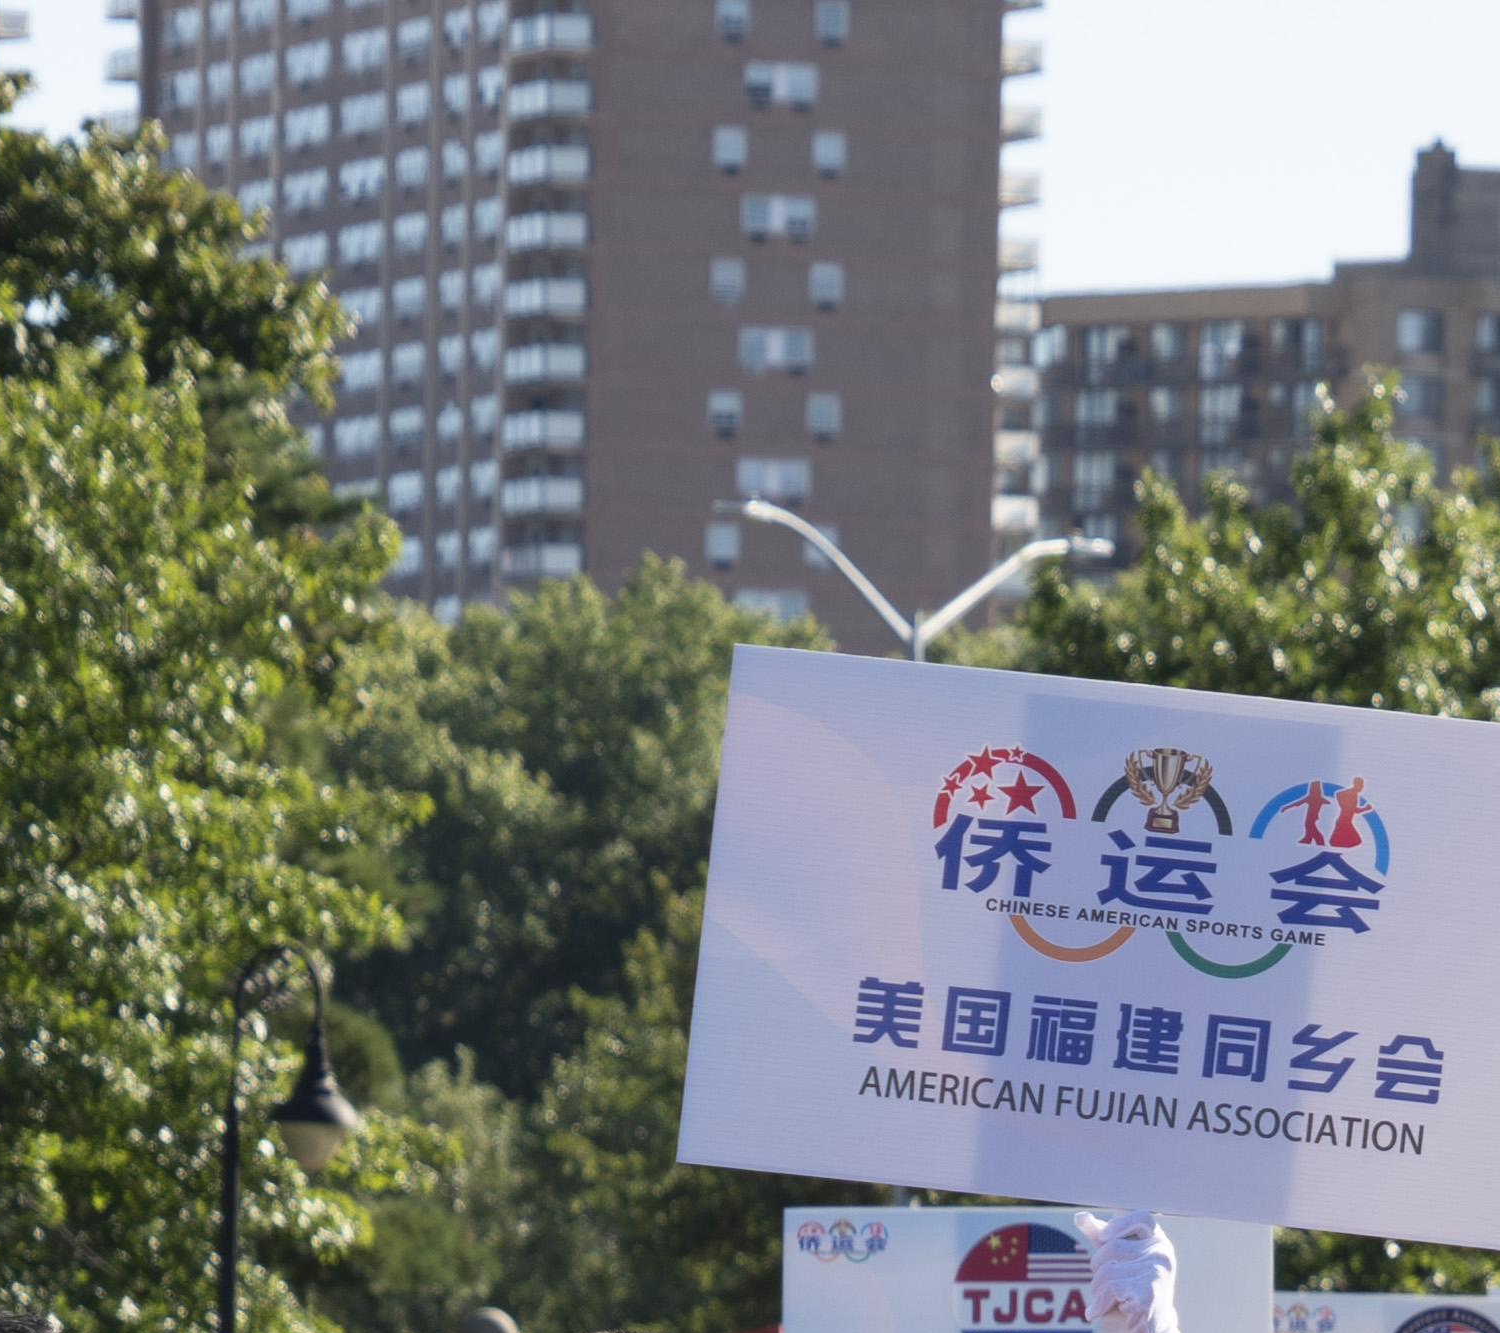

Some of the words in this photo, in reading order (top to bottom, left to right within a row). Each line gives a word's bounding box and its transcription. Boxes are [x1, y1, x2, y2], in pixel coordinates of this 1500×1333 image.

[934, 813, 1386, 934] 侨运会
[985, 898, 1070, 919] CHINESE
[1076, 908, 1179, 931] AMERICAN
[1186, 919, 1263, 940] SPORTS
[1270, 928, 1326, 946] GAME
[852, 976, 1445, 1105] 美国福建同乡会
[858, 1066, 1043, 1115] AMERICAN
[1054, 1085, 1178, 1129] FUJIAN
[1186, 1100, 1426, 1155] ASSOCIATION
[963, 1289, 1091, 1324] TJCA
